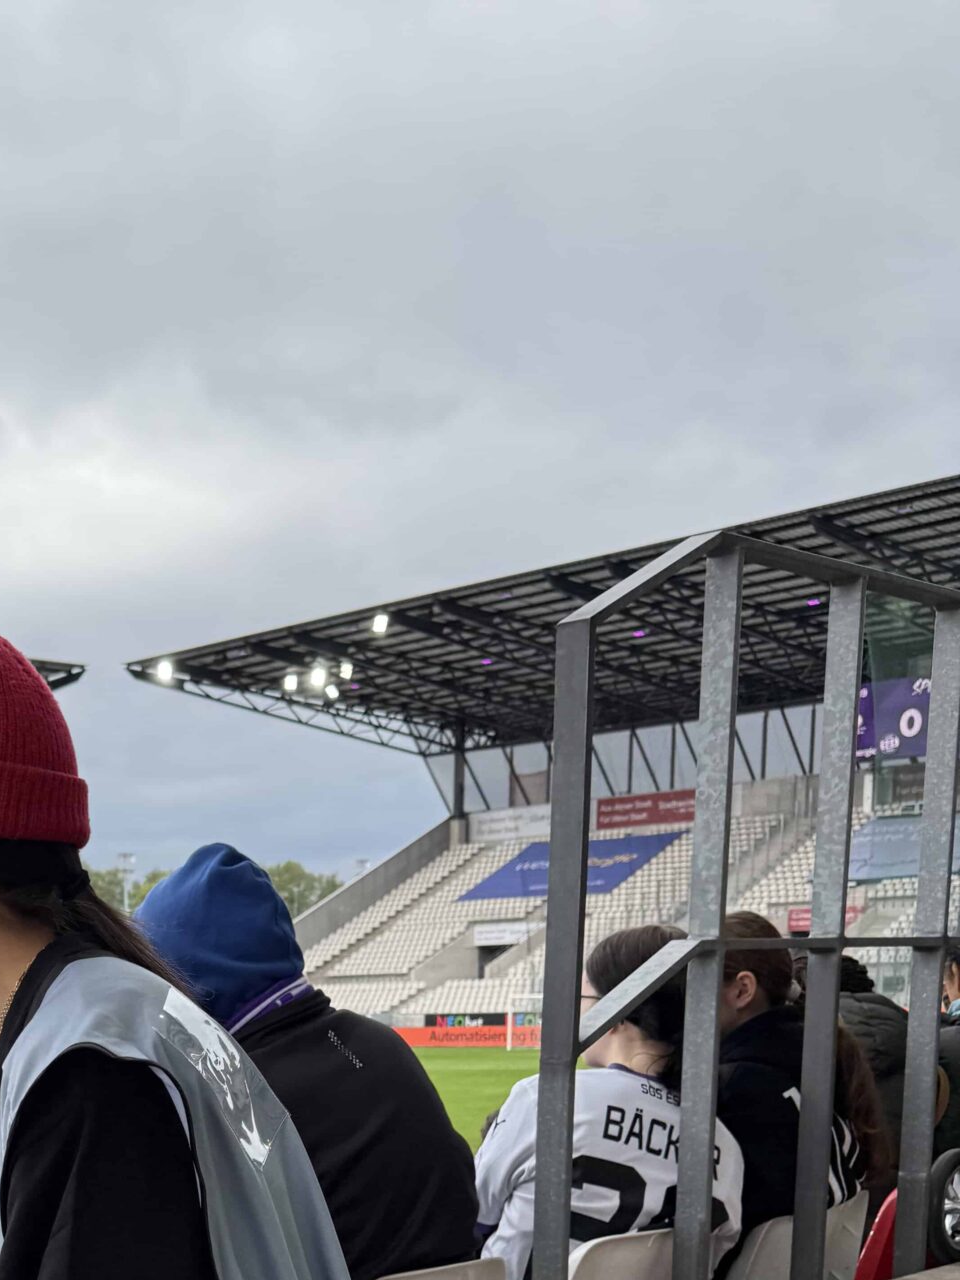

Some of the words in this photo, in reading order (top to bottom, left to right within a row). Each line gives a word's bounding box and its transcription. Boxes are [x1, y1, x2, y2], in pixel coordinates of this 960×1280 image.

[899, 708, 923, 738] 0
[640, 1083, 663, 1100] SGS
[603, 1104, 720, 1181] BÄCKR
